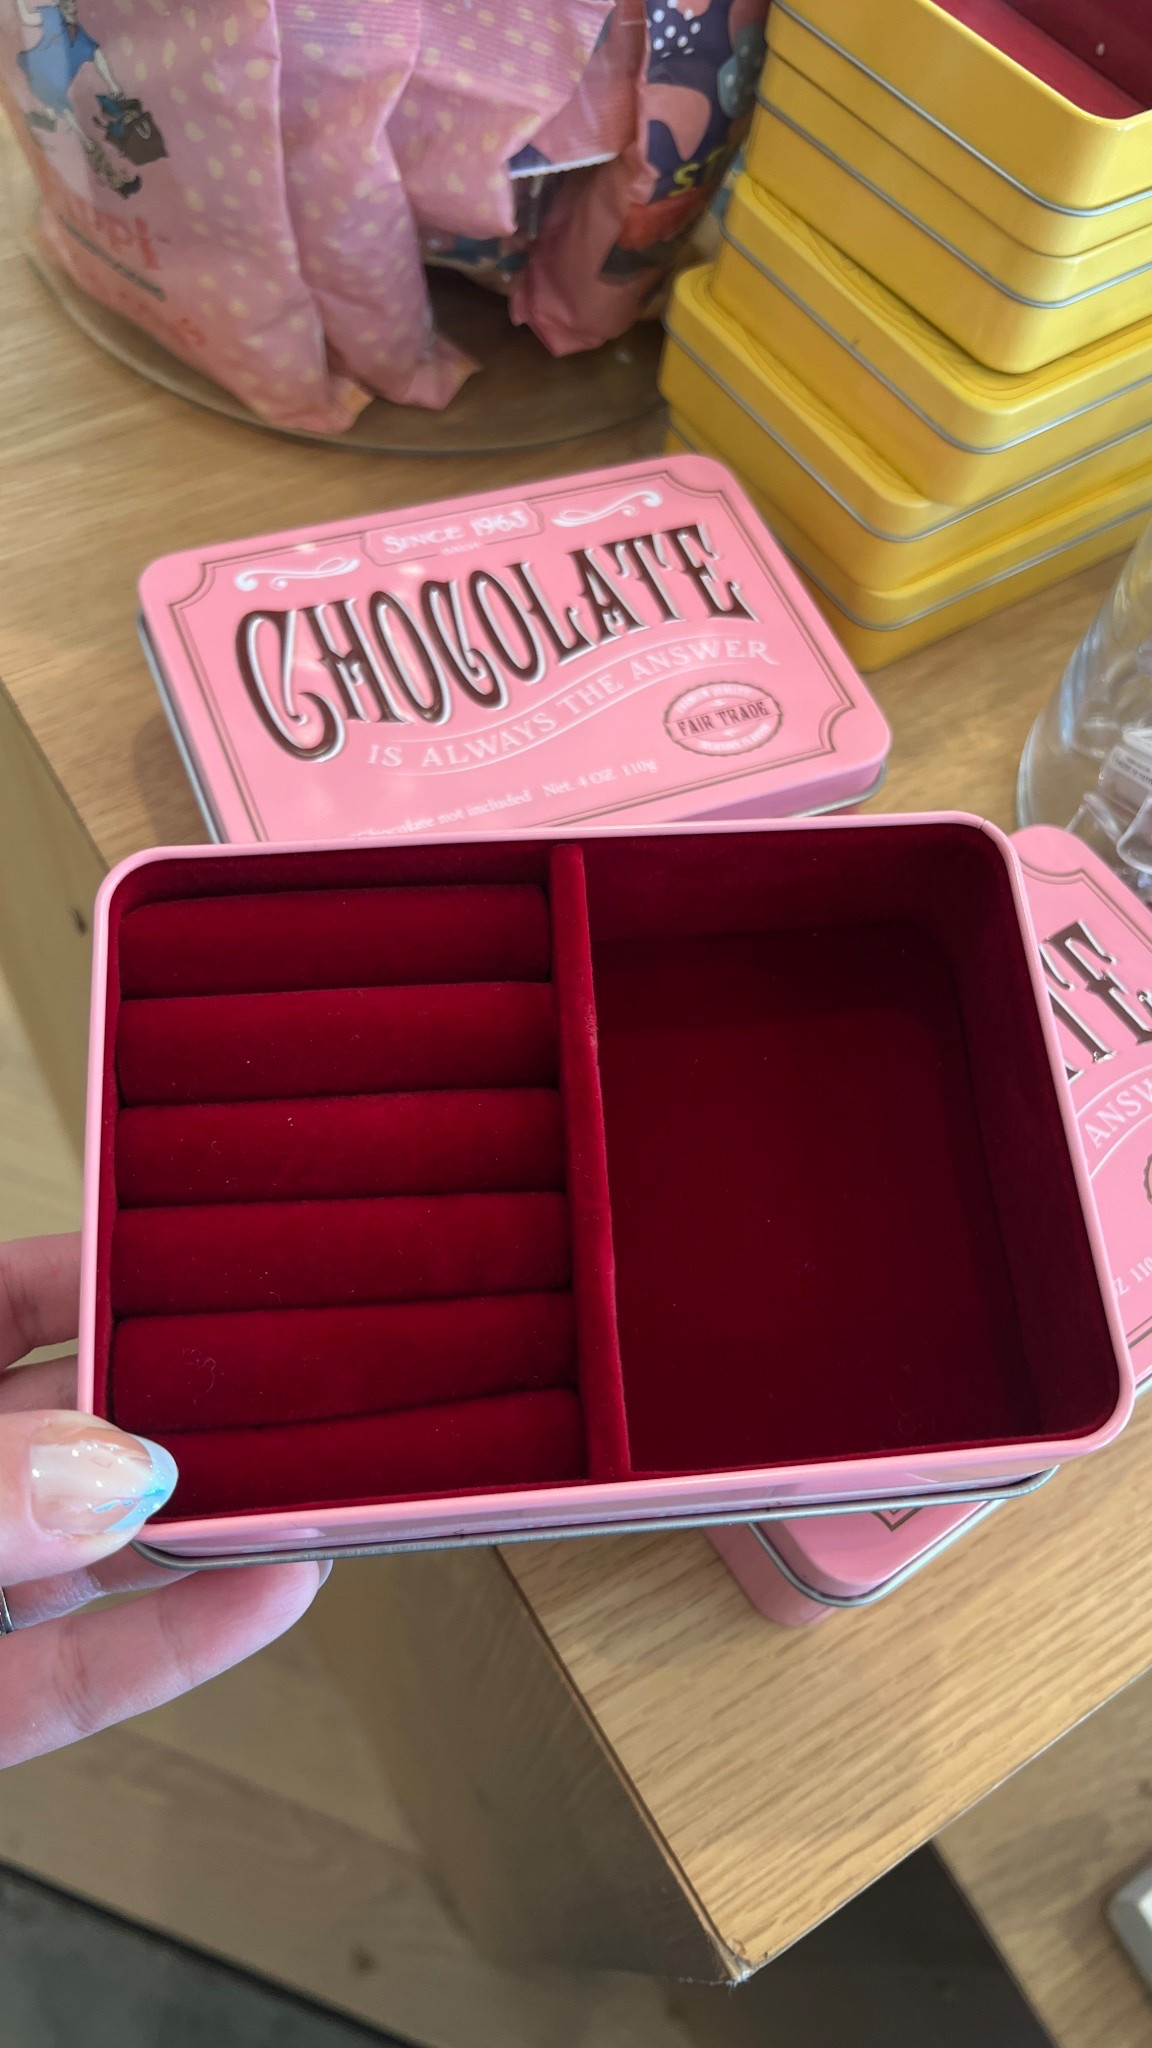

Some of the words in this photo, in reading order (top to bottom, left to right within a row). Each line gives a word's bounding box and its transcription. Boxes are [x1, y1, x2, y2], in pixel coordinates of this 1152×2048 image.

[470, 510, 529, 537] 1963
[234, 523, 761, 763] CHOCOLATE
[367, 744, 403, 767] IS
[421, 711, 557, 768] ALWAYS
[556, 673, 625, 715] THE
[629, 639, 781, 681] ANSWER
[677, 714, 718, 737] FAIR
[715, 700, 770, 726] TRADE
[350, 816, 436, 837] ocolate
[436, 807, 467, 825] not
[466, 788, 533, 817] included
[621, 758, 660, 779] 110g
[1039, 919, 1152, 1084] TE
